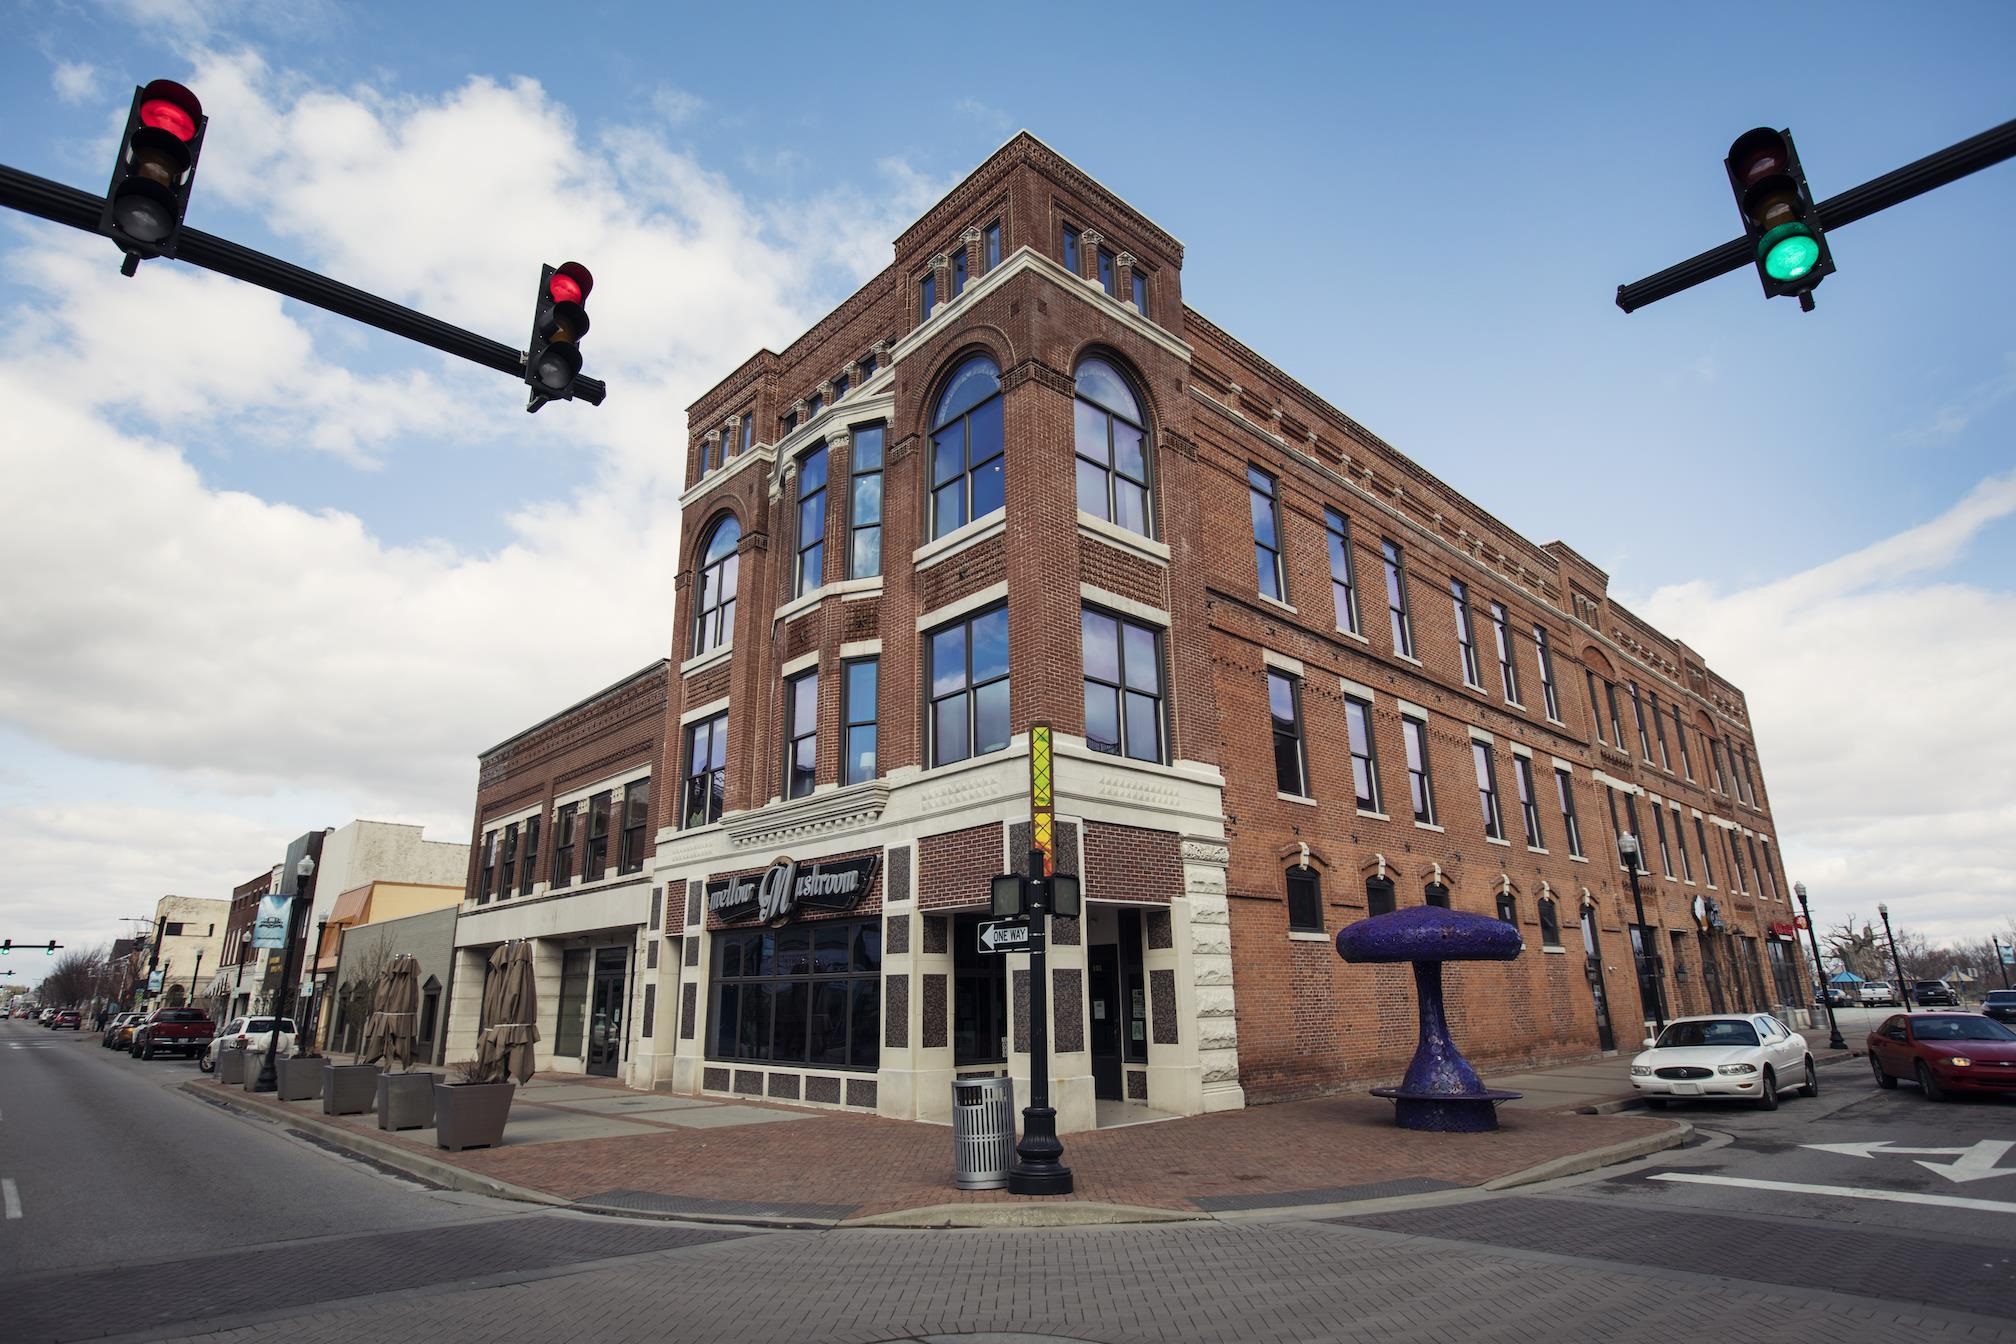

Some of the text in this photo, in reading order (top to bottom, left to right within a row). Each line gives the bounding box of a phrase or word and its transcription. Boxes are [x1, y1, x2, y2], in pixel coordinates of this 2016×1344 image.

[709, 863, 858, 922] mellow Mushroom
[993, 928, 1026, 942] ONE WAY
